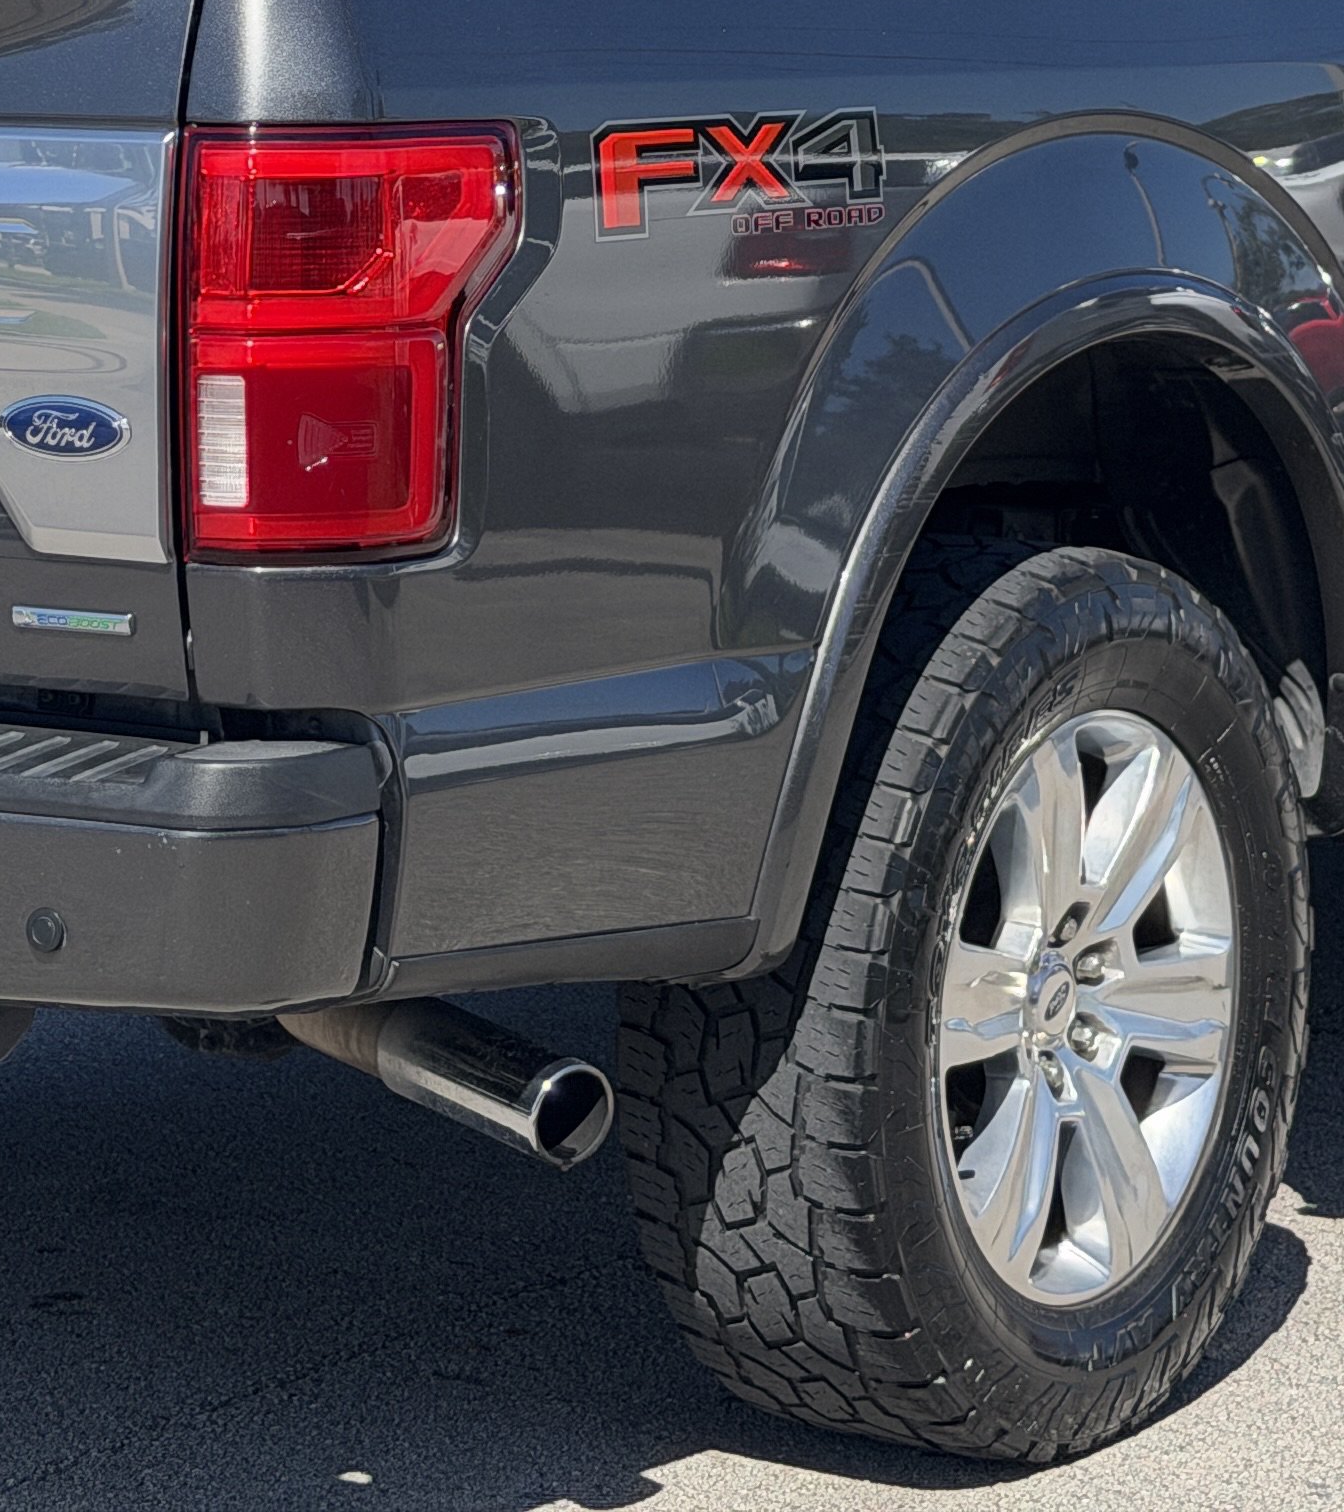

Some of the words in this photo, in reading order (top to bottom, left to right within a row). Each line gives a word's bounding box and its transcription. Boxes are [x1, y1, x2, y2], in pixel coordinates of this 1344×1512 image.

[590, 106, 886, 243] FX4
[732, 209, 794, 236] OFF
[805, 203, 885, 231] ROAD
[25, 409, 97, 448] Ford
